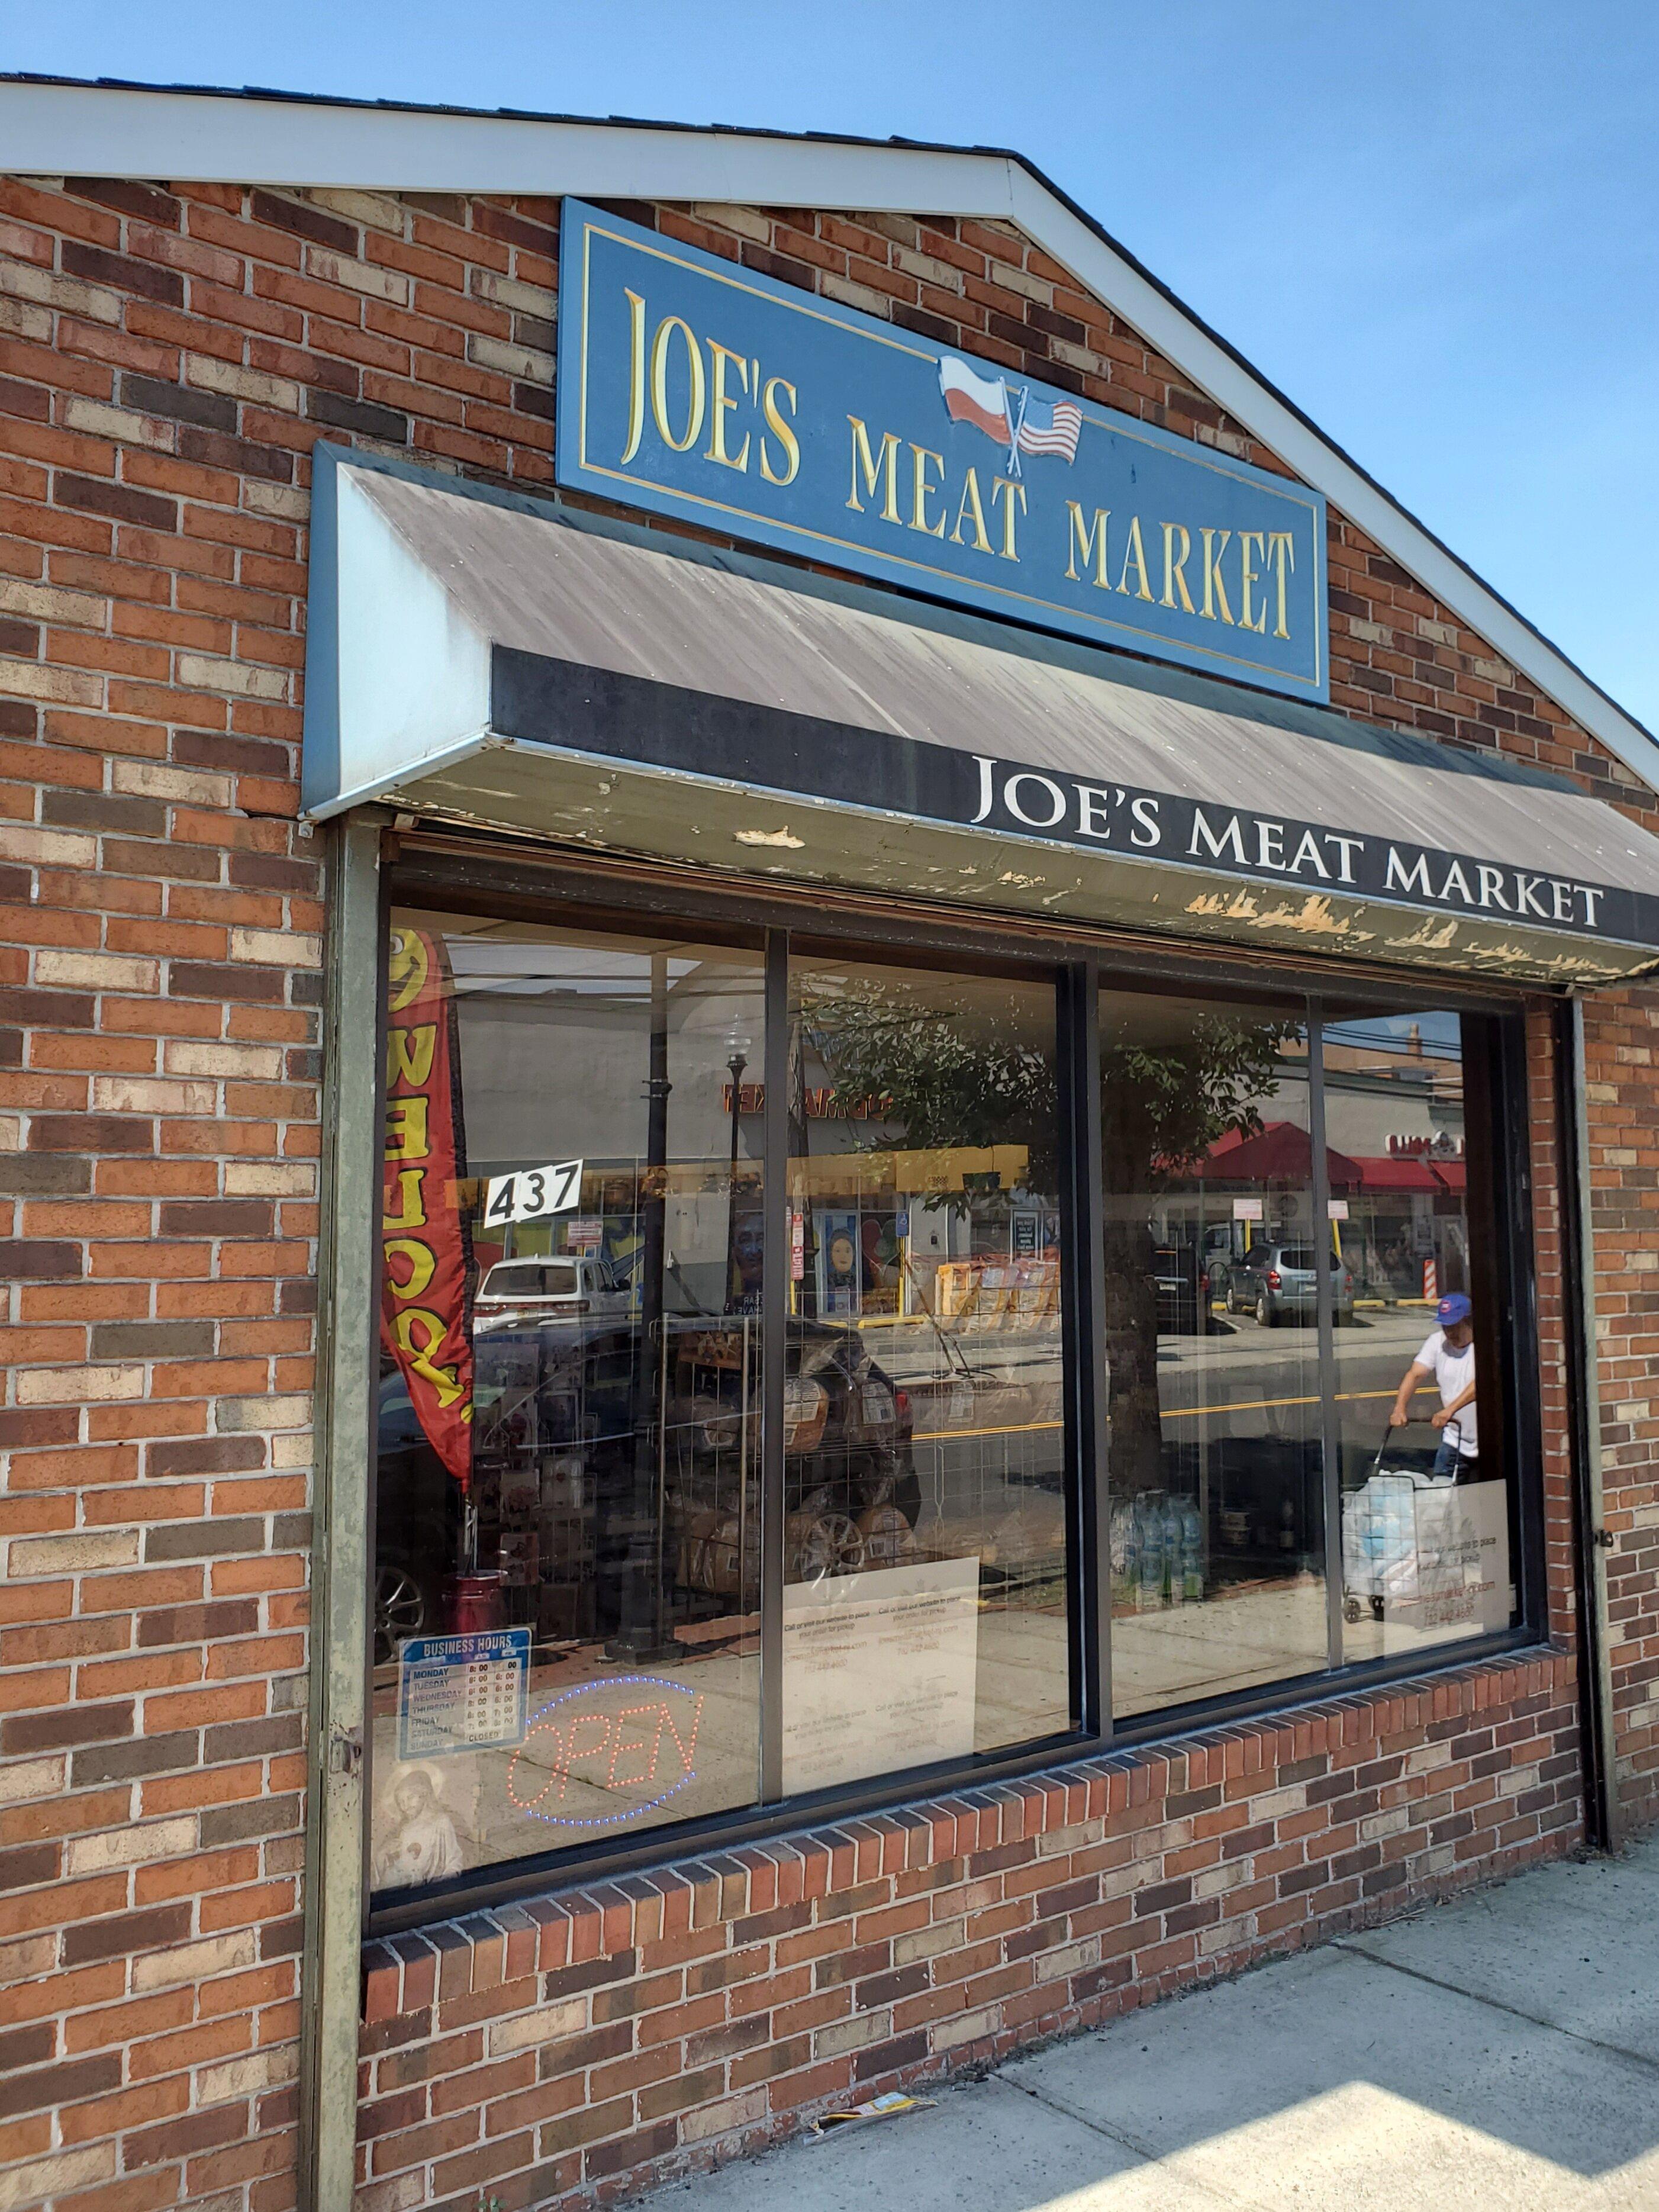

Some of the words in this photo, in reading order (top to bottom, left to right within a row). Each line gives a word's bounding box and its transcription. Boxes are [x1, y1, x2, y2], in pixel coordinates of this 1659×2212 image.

[621, 286, 800, 486] JOE'S
[845, 414, 1027, 563] MEAT
[1064, 500, 1295, 640] MARKET
[971, 756, 1161, 848] JOE'S
[1185, 807, 1364, 883] MEAT
[1382, 846, 1604, 928] MARKET
[489, 1164, 578, 1219] 437
[424, 1640, 474, 1657] BUSINESS
[478, 1635, 512, 1651] HOURS
[414, 1667, 449, 1680] MONDAY
[414, 1680, 449, 1691] TUESDAY
[413, 1690, 462, 1702] WEDNESDAY
[413, 1702, 455, 1714] THURSDAY
[469, 1731, 499, 1742] CLOSED
[508, 1695, 704, 1808] OPEN
